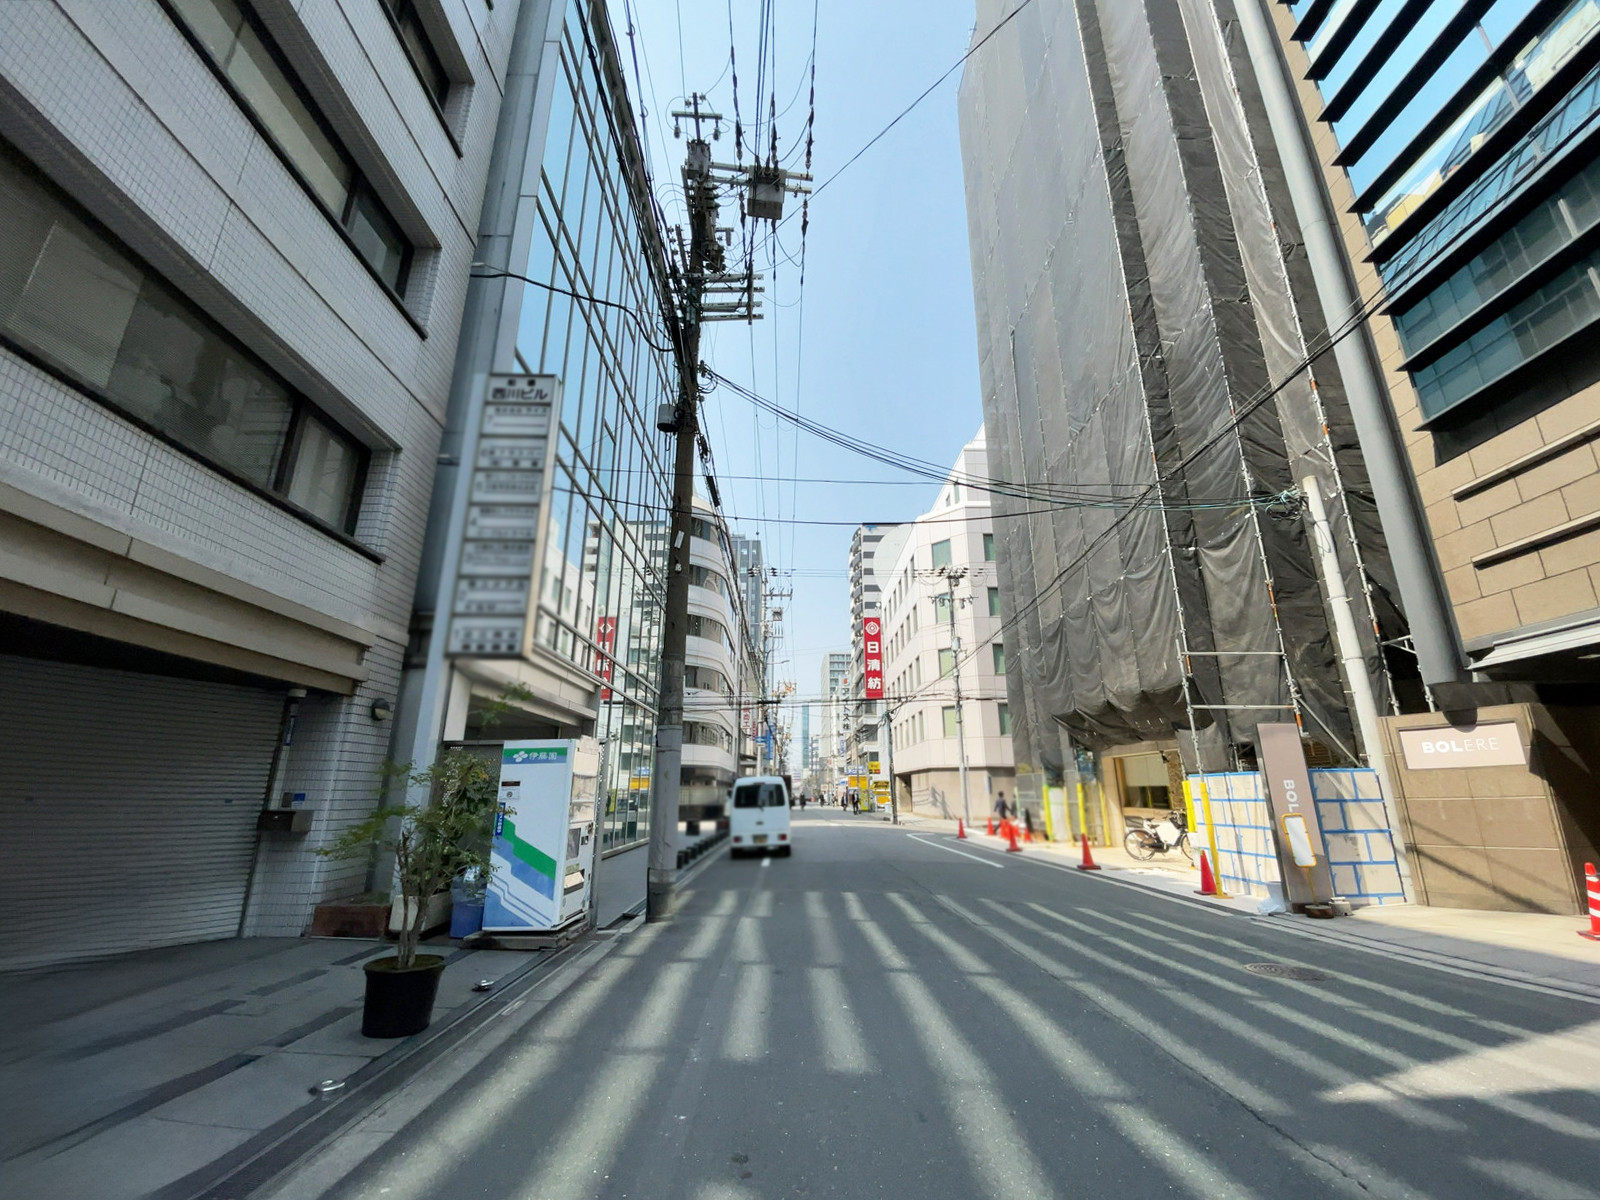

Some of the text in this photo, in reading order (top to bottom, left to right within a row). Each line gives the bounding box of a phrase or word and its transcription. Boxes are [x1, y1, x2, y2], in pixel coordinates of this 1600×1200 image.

[492, 387, 548, 400] 西川ビル
[867, 641, 881, 690] 日清紡
[1421, 737, 1500, 754] BOLERE
[529, 751, 557, 761] 伊藤園
